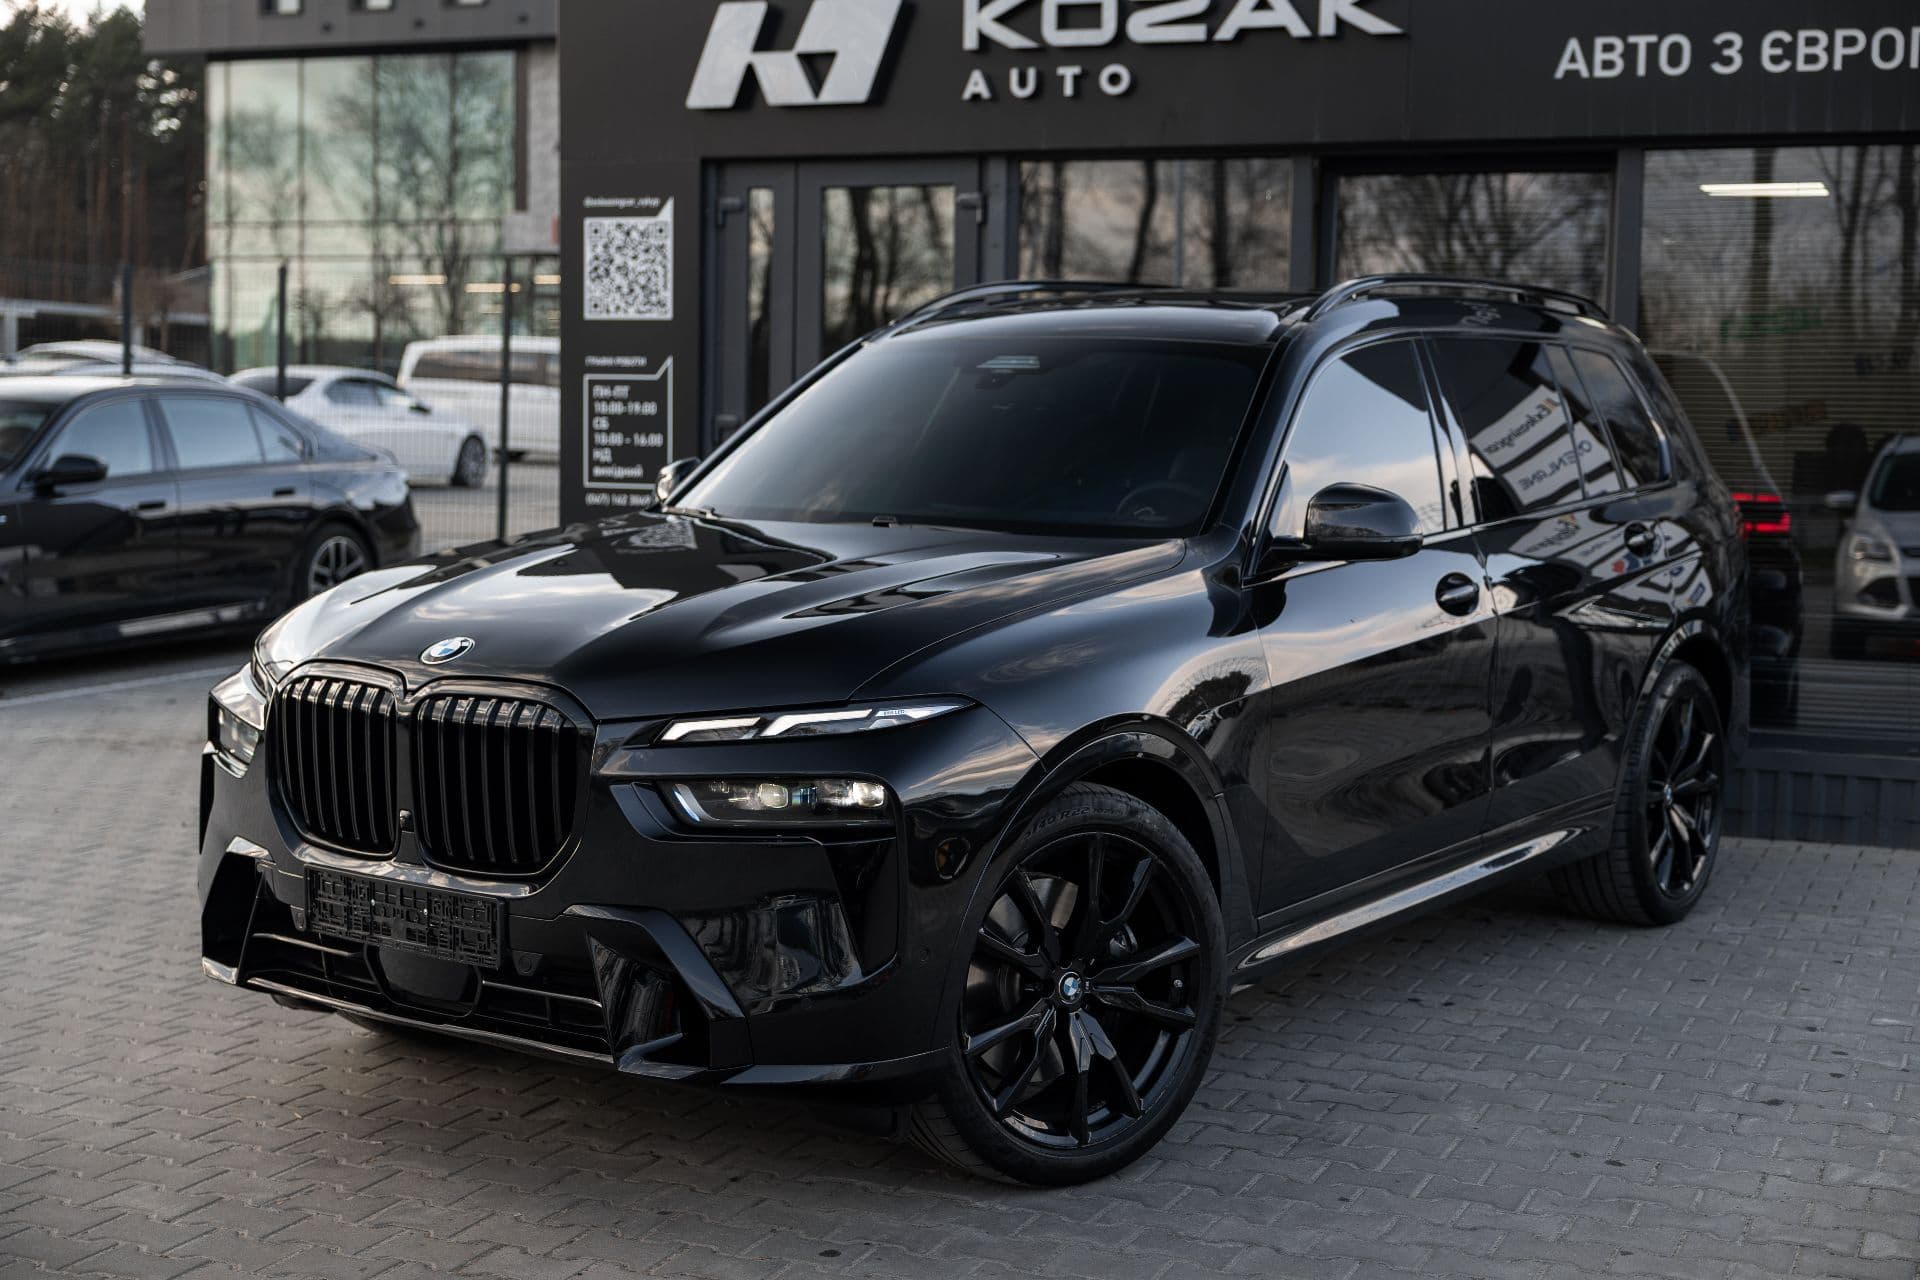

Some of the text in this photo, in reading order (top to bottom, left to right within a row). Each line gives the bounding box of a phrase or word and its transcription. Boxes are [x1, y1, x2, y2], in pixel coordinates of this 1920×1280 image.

[962, 0, 1404, 51] KOZAK
[1553, 34, 1692, 80] АВТО
[1710, 31, 1744, 75] З
[962, 63, 1132, 101] AUTO
[592, 416, 610, 430] СБ
